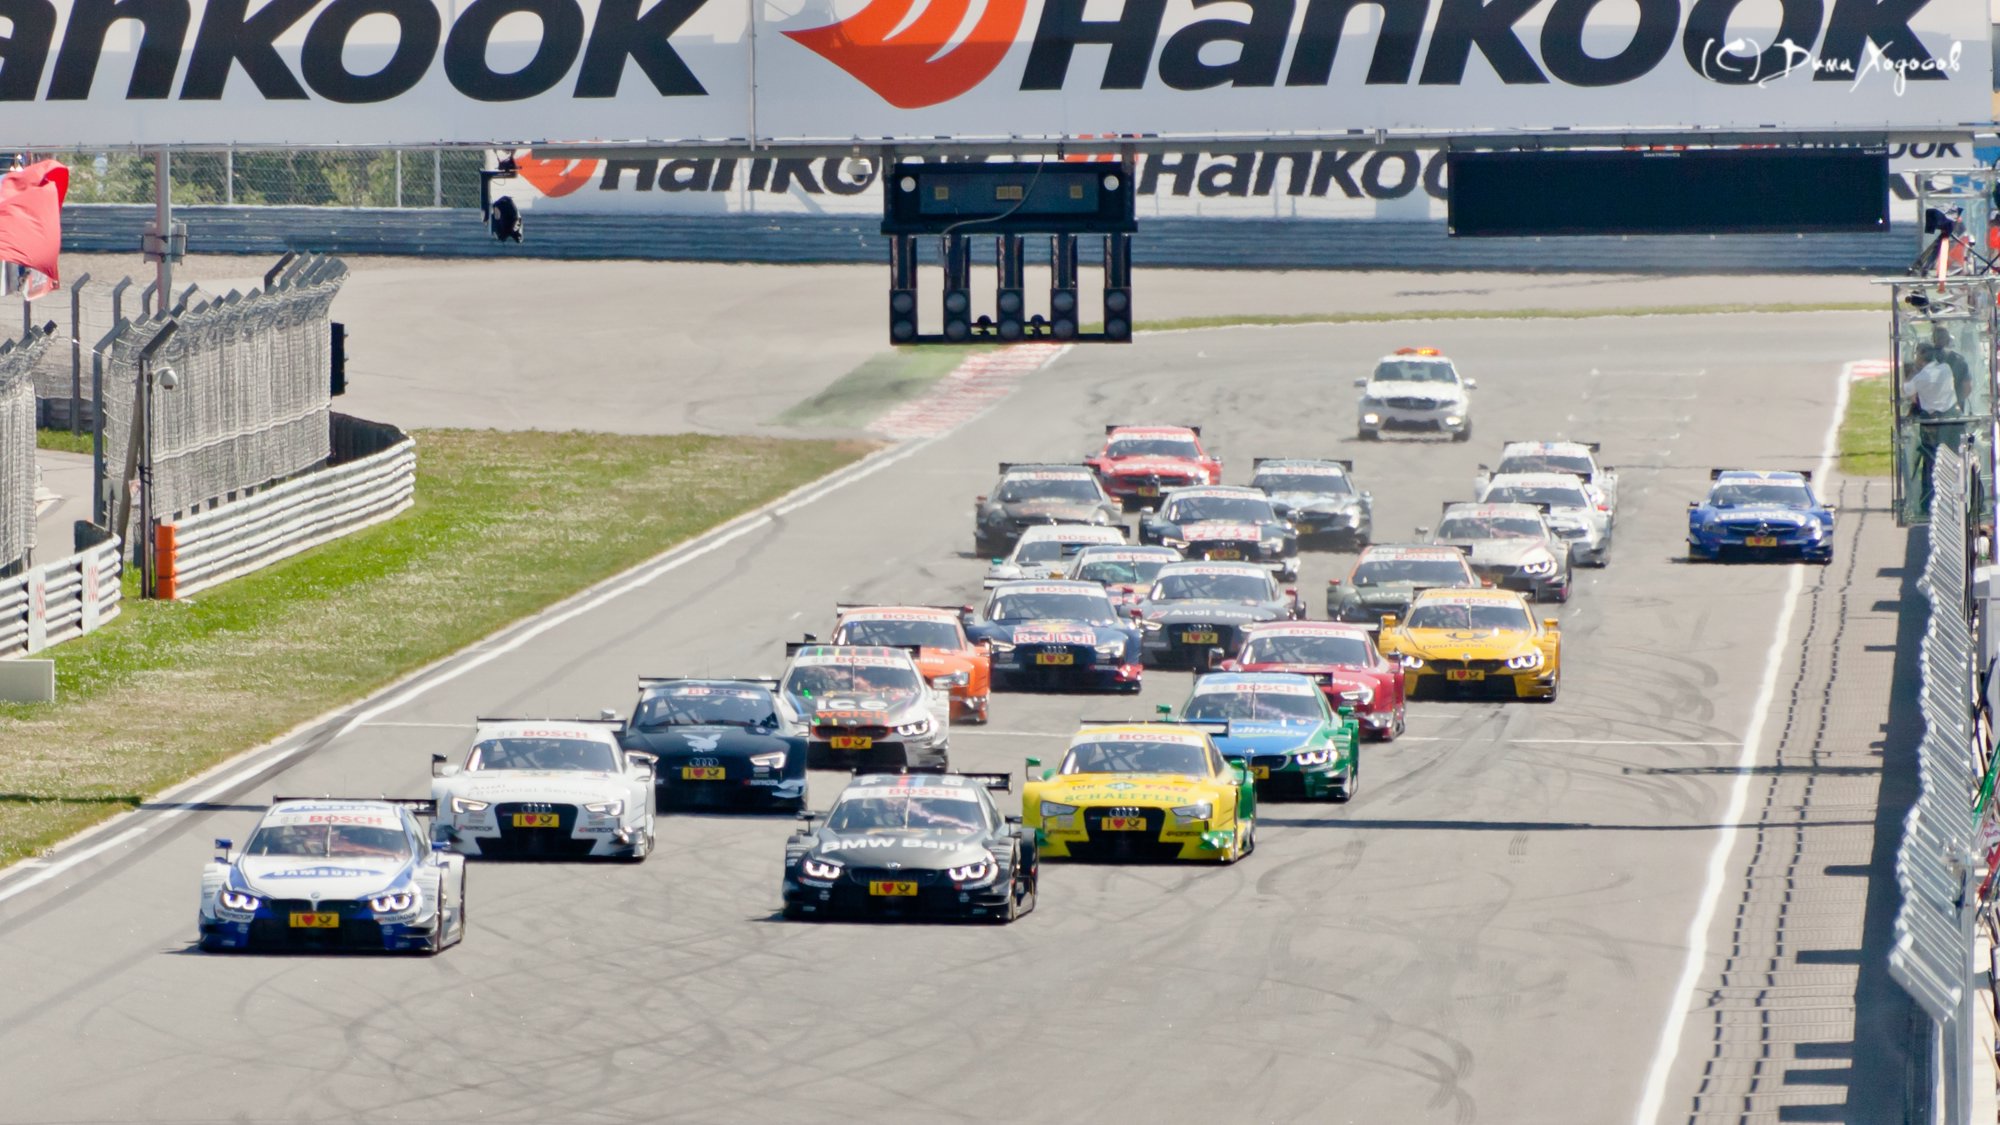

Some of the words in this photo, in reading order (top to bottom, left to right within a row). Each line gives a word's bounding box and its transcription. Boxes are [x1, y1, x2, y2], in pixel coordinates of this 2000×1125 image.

[599, 156, 886, 196] Hanko
[835, 656, 896, 666] BOSCH
[1237, 683, 1299, 693] BOSCH
[522, 729, 589, 739] BOSCH
[1118, 733, 1185, 743] BOSCH
[888, 787, 959, 797] BOSCH
[309, 814, 383, 825] BOSCH
[821, 837, 897, 854] BMW
